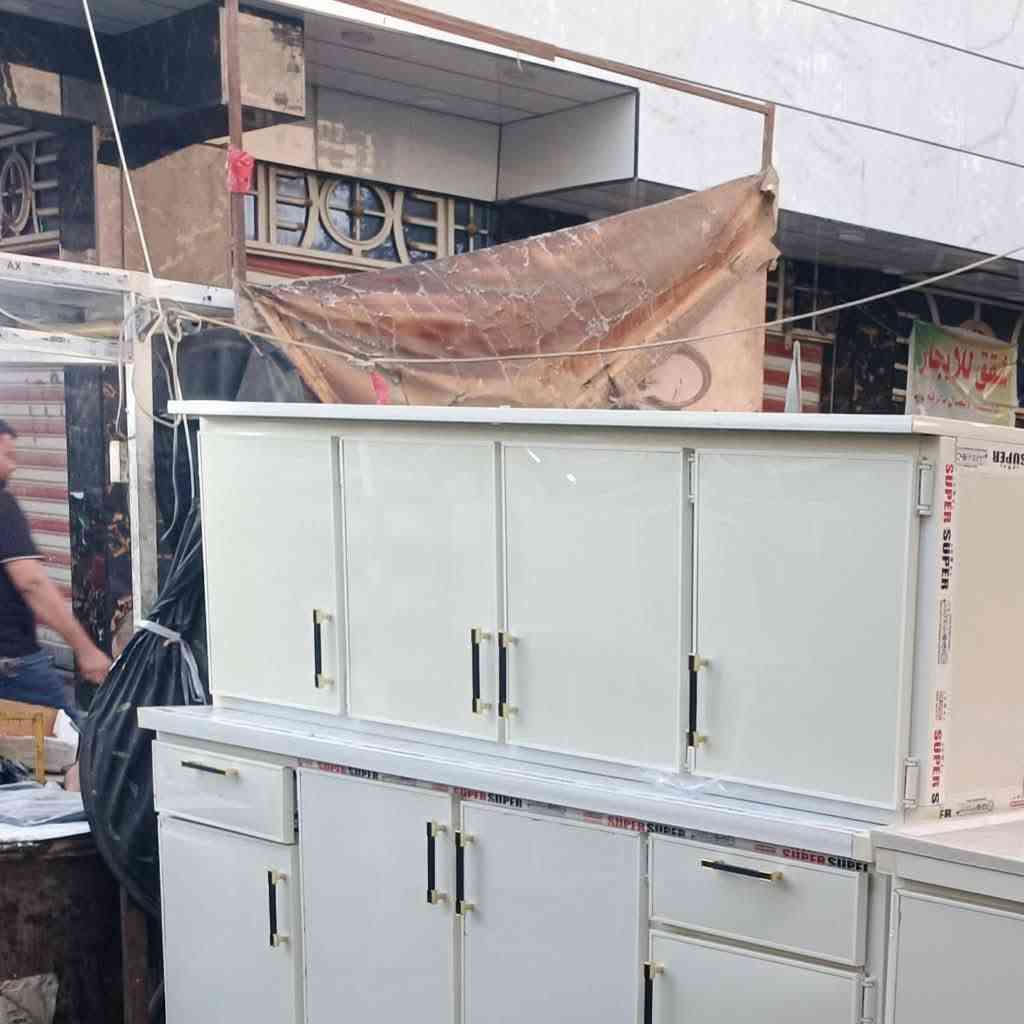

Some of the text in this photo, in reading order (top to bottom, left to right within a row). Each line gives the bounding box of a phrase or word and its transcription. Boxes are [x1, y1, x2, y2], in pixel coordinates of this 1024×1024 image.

[944, 463, 953, 523] SUPER
[941, 528, 951, 590] SUPER
[932, 729, 942, 787] SUPER
